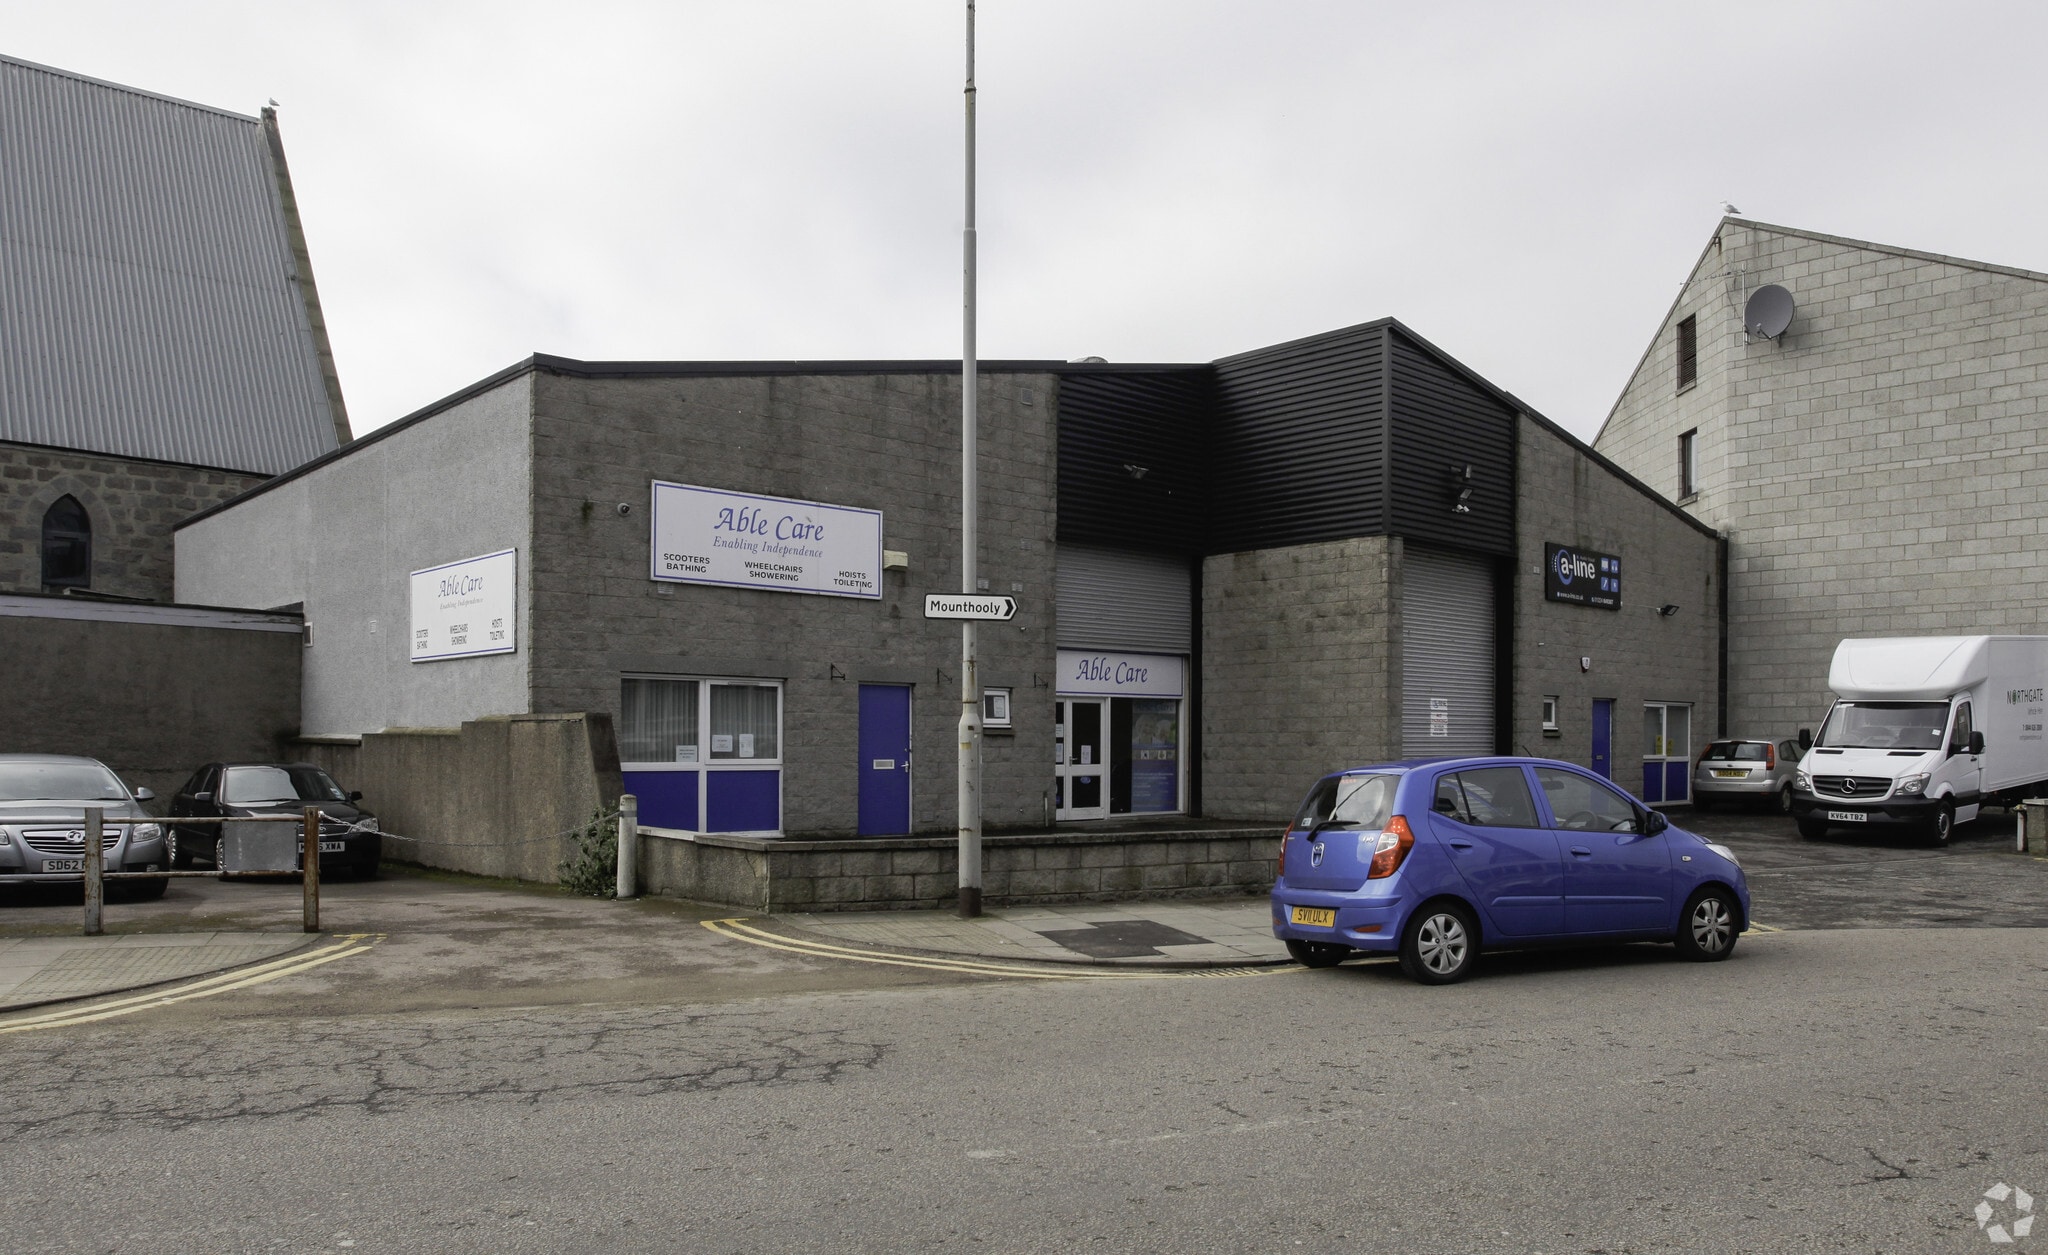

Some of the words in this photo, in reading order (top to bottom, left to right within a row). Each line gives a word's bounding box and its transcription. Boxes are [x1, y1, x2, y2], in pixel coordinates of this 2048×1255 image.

[713, 506, 768, 536] Able
[775, 515, 825, 541] Care
[712, 536, 759, 554] Enabling
[762, 541, 824, 558] Independence
[663, 553, 711, 565] SCOOTERS
[666, 562, 708, 573] BATHING
[744, 561, 804, 574] WHEELCHAIRS
[749, 570, 800, 582] SHOWERING
[838, 570, 867, 580] HOISTS
[438, 574, 460, 598] Able
[460, 574, 483, 596] Care
[833, 578, 873, 589] TOILETING
[930, 600, 1001, 616] Mounthooly
[1075, 656, 1112, 682] Able
[1115, 661, 1149, 685] Care
[48, 860, 79, 871] SD62
